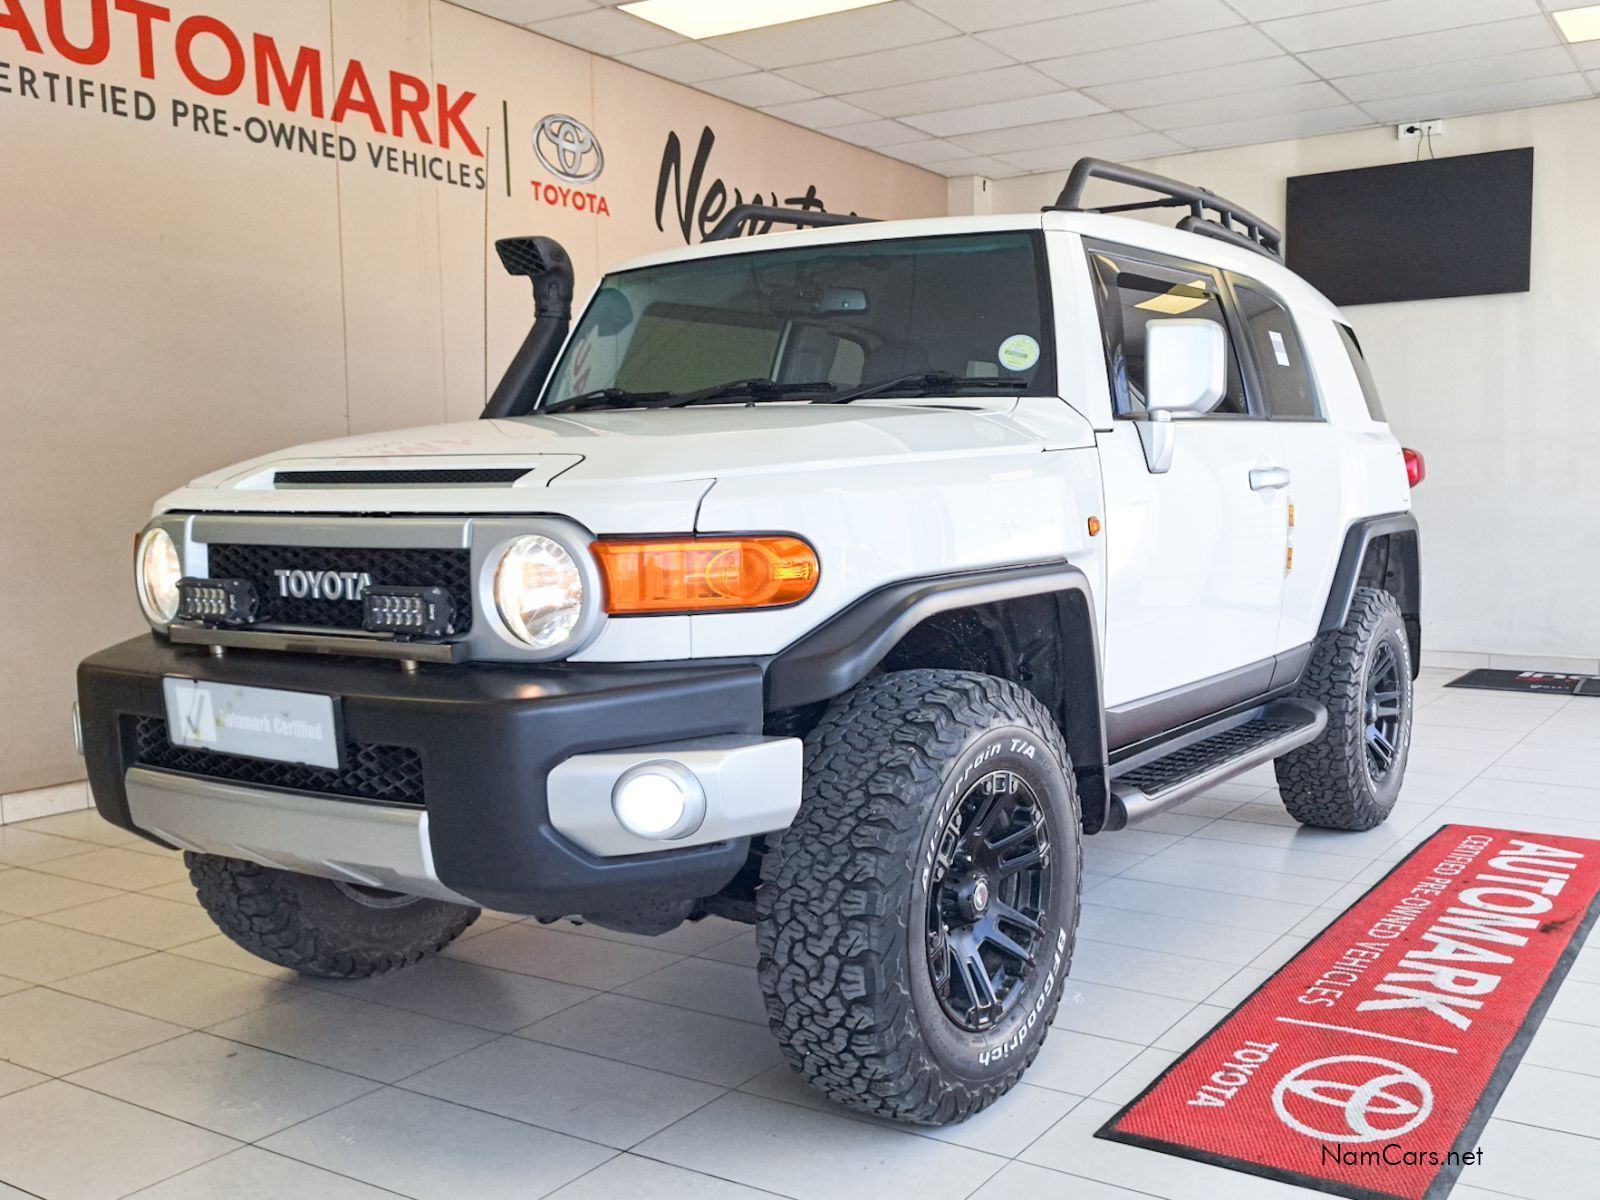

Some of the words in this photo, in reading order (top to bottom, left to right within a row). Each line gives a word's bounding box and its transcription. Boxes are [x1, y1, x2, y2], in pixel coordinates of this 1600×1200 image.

[0, 0, 485, 158] AUTOMARK
[172, 99, 356, 162] PRE-OWNED
[367, 142, 486, 190] VEHICLES
[531, 180, 610, 217] TOYOTA
[274, 569, 371, 600] TOYOTA
[272, 717, 323, 741] Certified
[1009, 738, 1036, 760] T/A
[1432, 834, 1493, 876] CERTIFIED
[1356, 838, 1584, 1031] AUTOMARK
[1367, 875, 1452, 939] PRE-OWNED
[978, 927, 1067, 1066] BFGoodrich
[1297, 941, 1390, 1008] VEHICLES
[1187, 1040, 1280, 1108] TOYOTA
